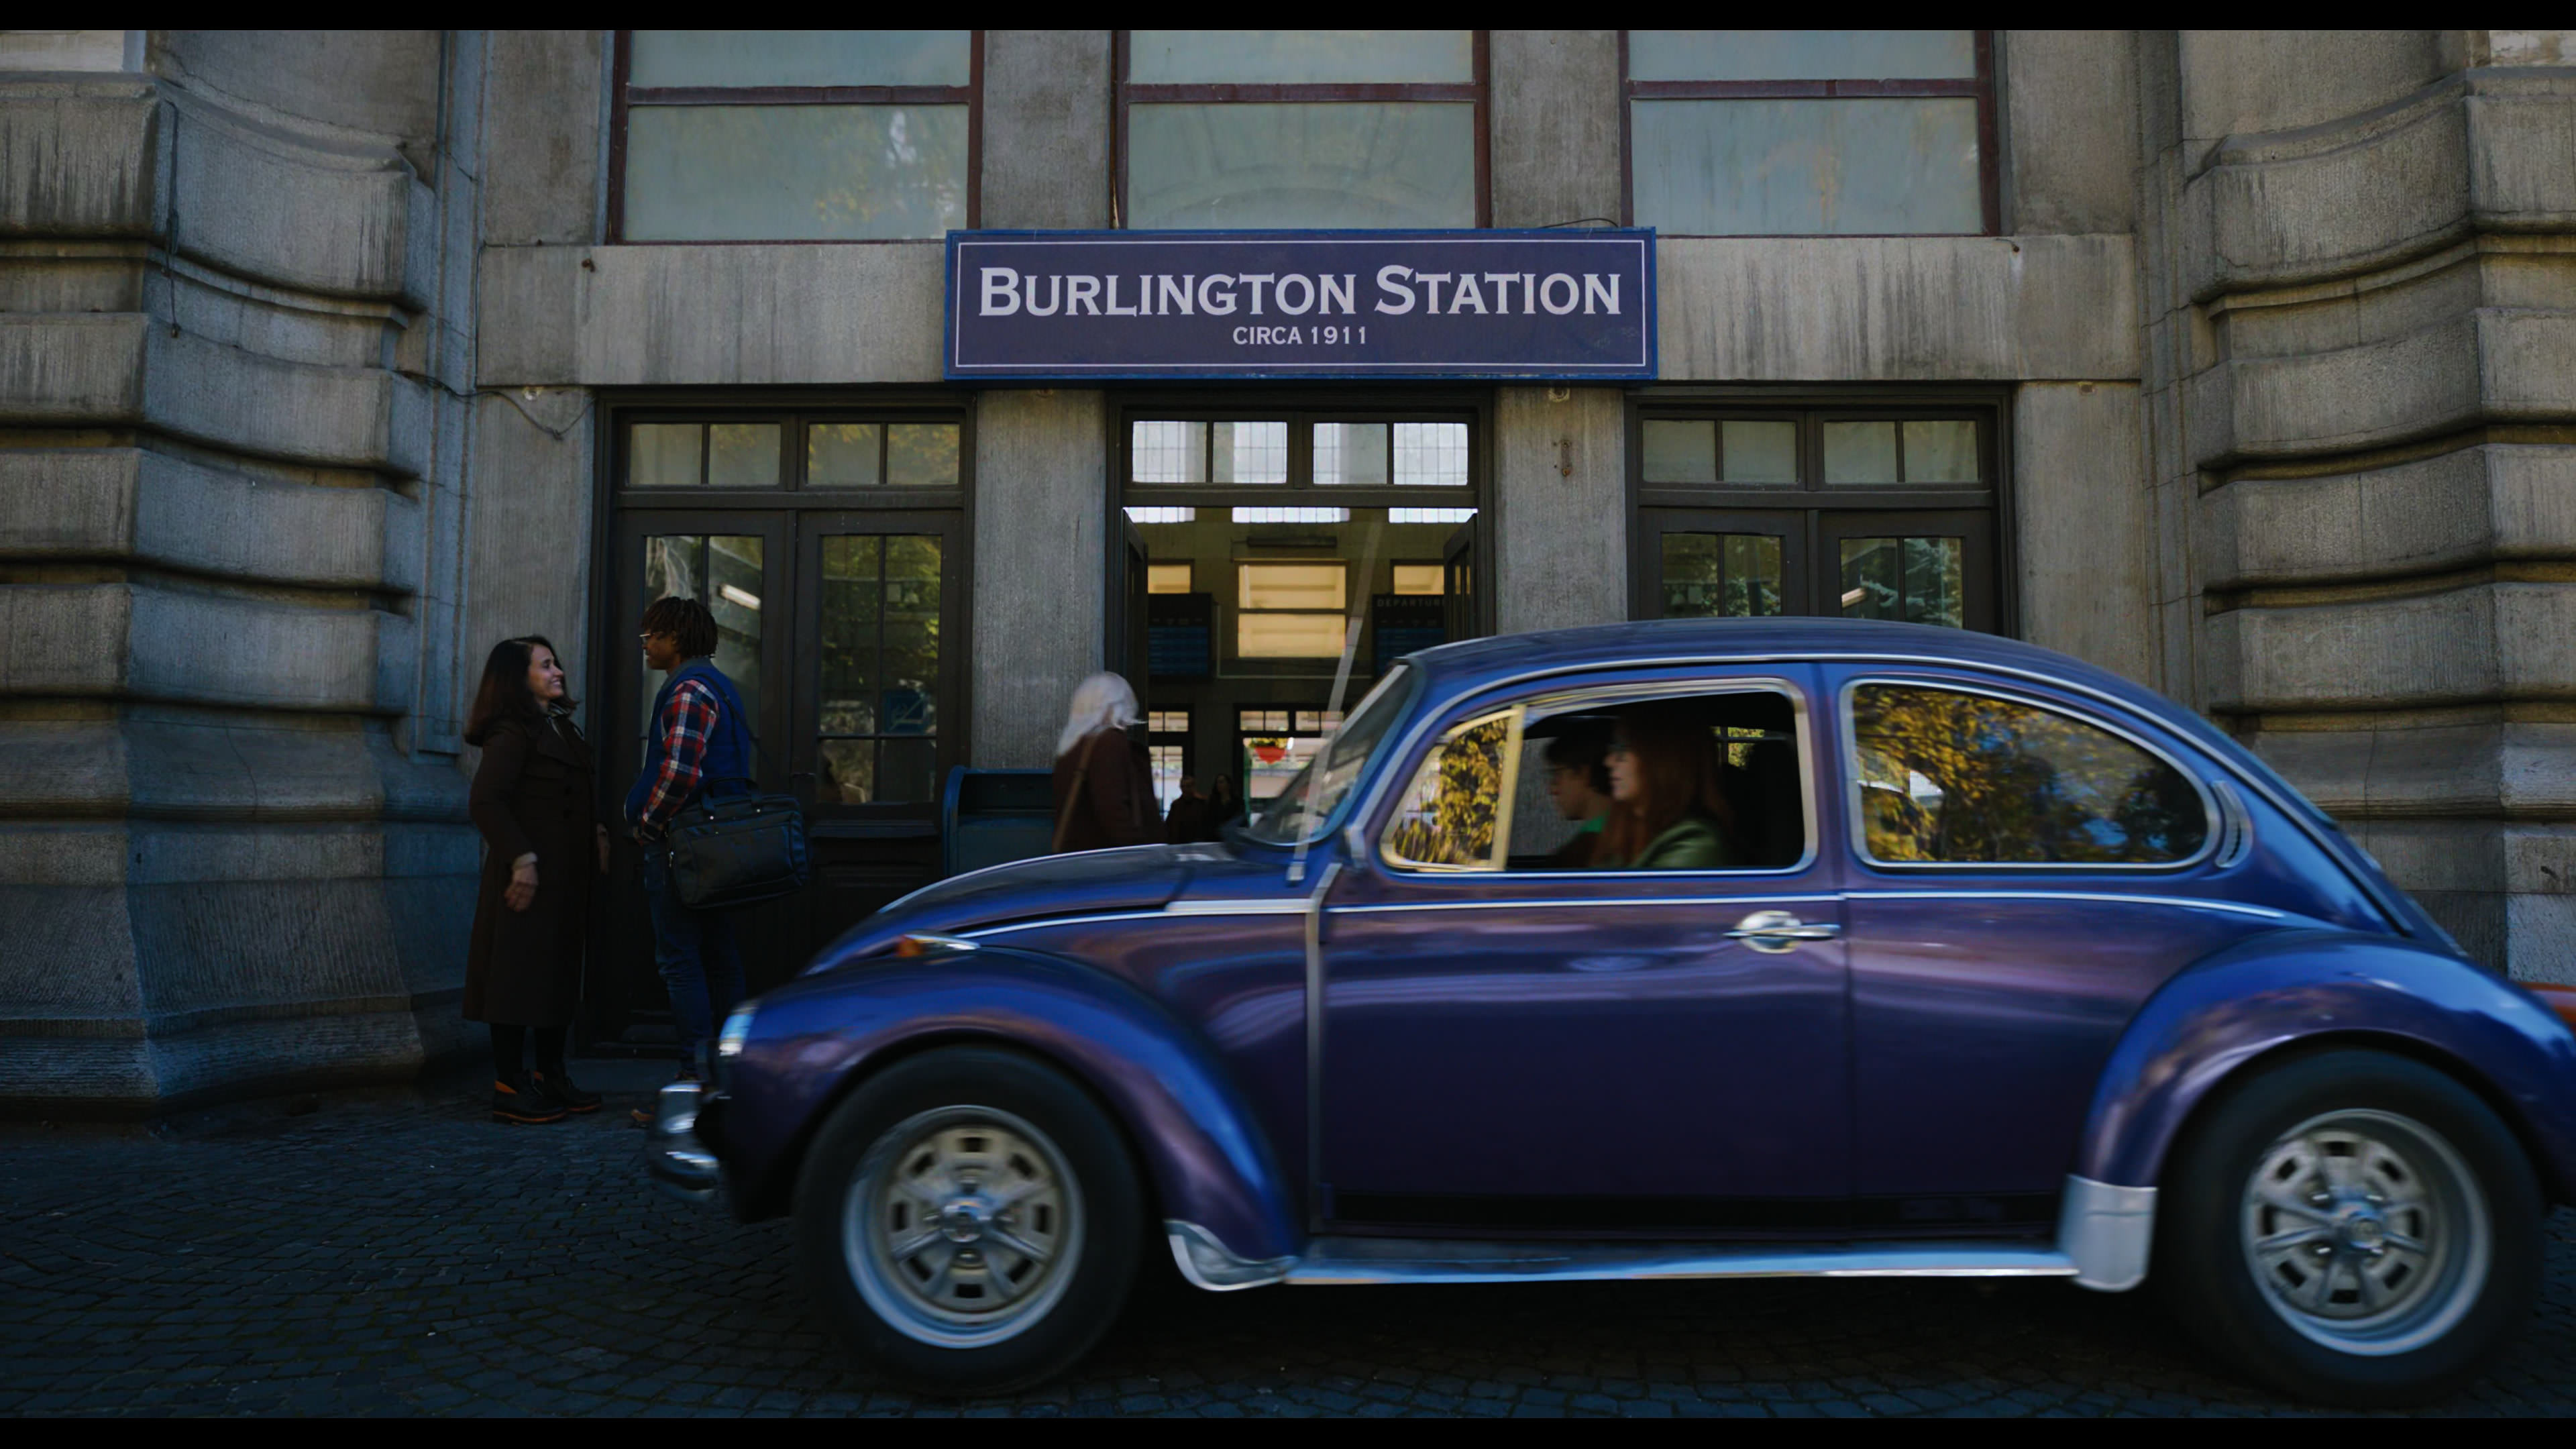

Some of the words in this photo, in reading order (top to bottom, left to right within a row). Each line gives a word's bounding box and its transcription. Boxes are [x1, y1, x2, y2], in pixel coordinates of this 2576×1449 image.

[979, 267, 1356, 317] BURLINGTON
[1375, 265, 1621, 315] STATION
[1233, 326, 1303, 345] CIRCA
[1311, 326, 1366, 345] 1911
[1377, 598, 1444, 607] DEPARTUR
